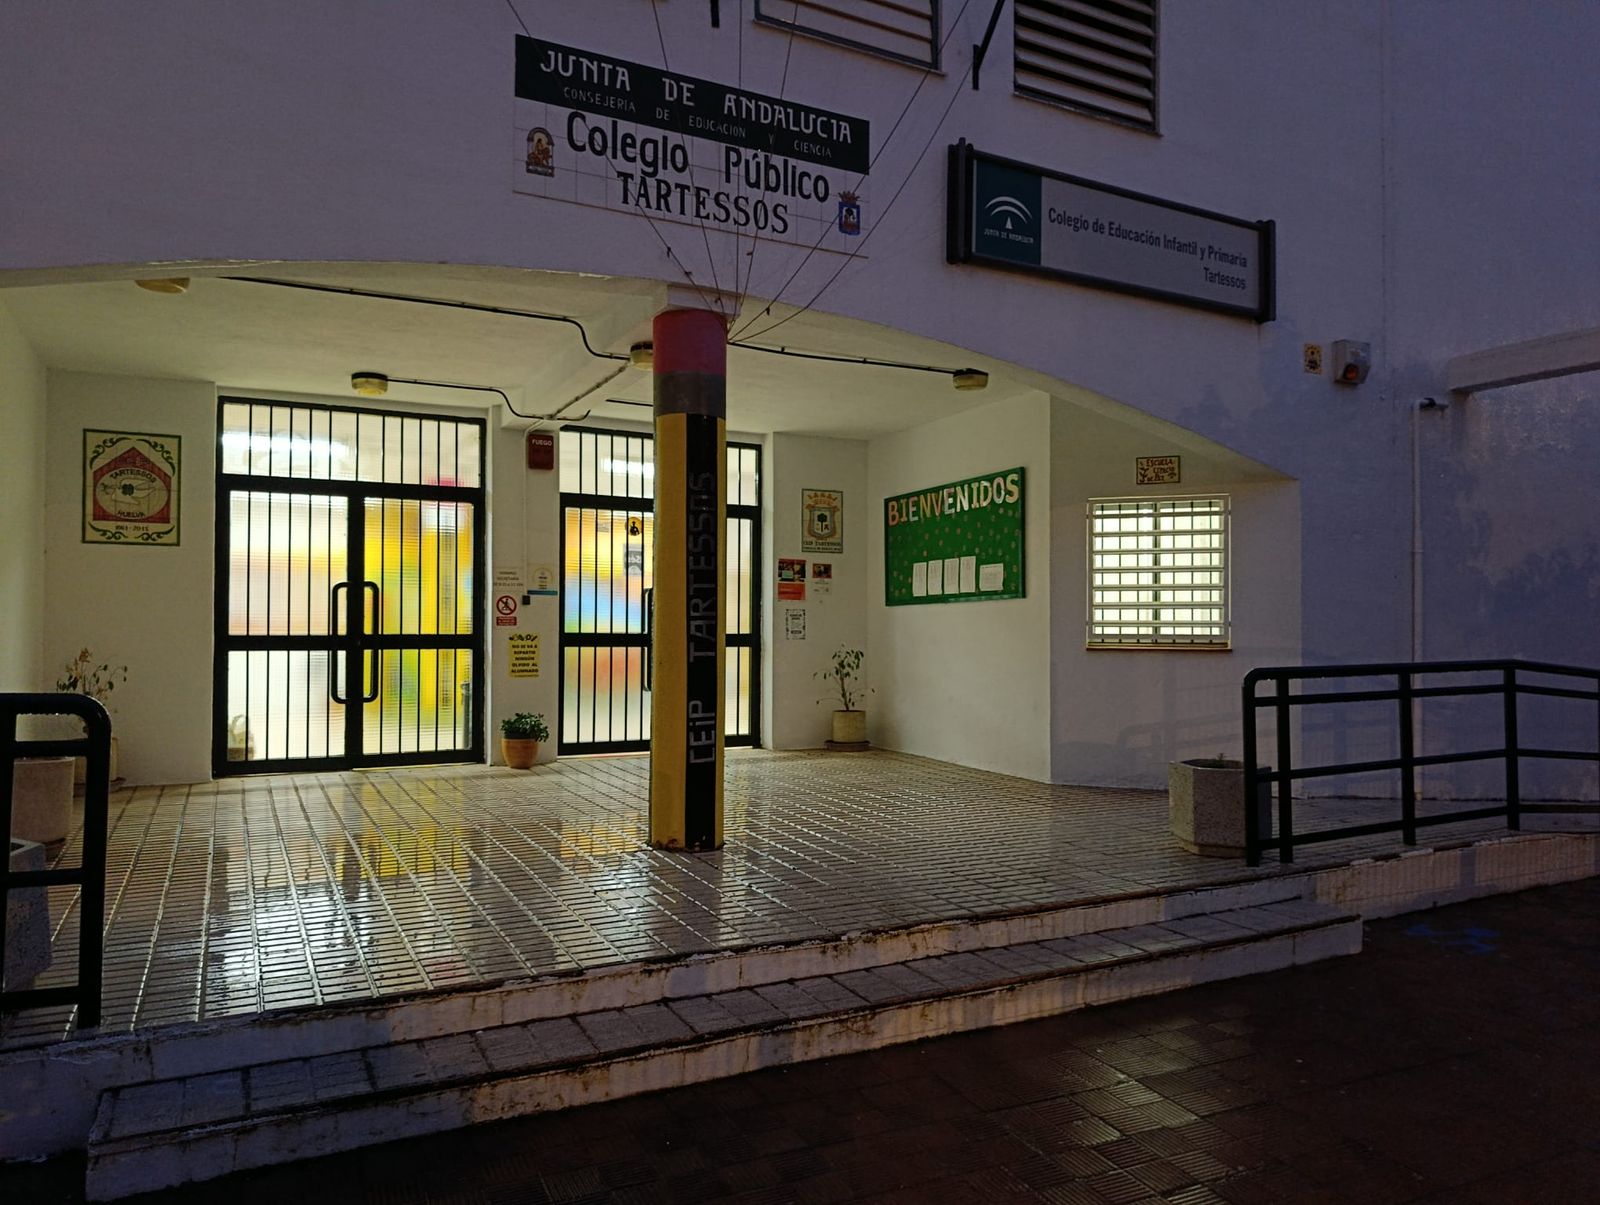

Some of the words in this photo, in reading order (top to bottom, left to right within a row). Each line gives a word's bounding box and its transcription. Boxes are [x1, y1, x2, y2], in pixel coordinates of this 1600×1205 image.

[540, 50, 631, 92] JUNTA
[662, 77, 695, 107] DE
[724, 93, 852, 144] ANDALUCIA
[563, 86, 636, 113] CONSEJERIA
[656, 106, 670, 121] DE
[689, 115, 746, 139] EDUCACION
[768, 132, 775, 145] Y
[794, 140, 832, 158] CIENCIA
[566, 111, 690, 178] Colegio
[724, 145, 830, 203] Público
[617, 171, 788, 234] TARTESSOS
[1048, 207, 1089, 233] Colegio
[1092, 218, 1105, 234] de
[1108, 221, 1161, 248] Educación
[1163, 233, 1198, 256] Infantil
[1199, 246, 1206, 261] y
[1208, 244, 1248, 268] Primaria
[1203, 266, 1247, 290] Tartessos
[109, 468, 157, 484] TARTESSOS
[888, 473, 1020, 527] BIENVENIDOS
